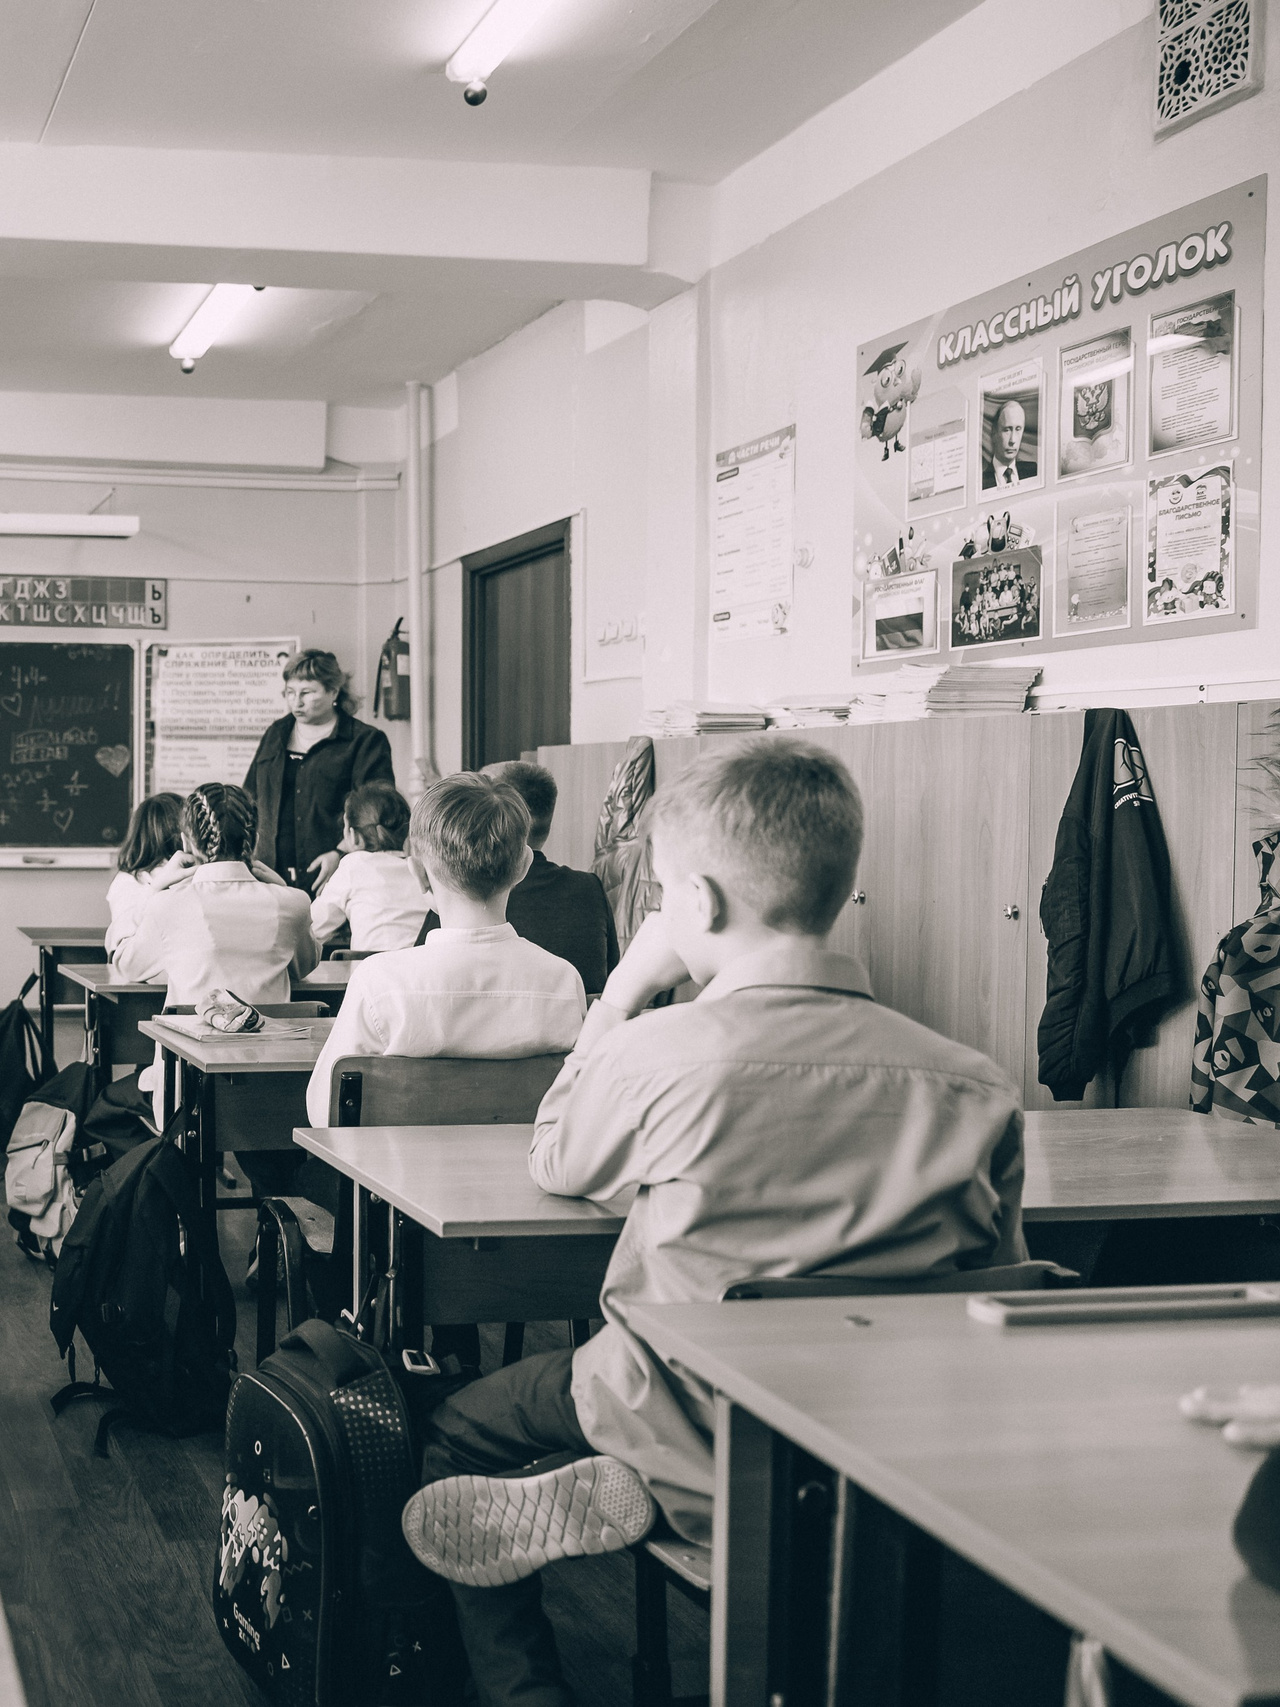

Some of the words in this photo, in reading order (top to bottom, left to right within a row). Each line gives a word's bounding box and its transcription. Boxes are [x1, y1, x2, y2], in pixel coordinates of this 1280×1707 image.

[938, 274, 1081, 366] КЛАССНЫЙ
[1092, 222, 1230, 306] УГОЛОК
[1175, 510, 1202, 521] ПИСЬМО
[201, 650, 270, 660] ОПРЕДЕЛИТЬ
[164, 660, 228, 668] СПРЯЖЕНИЕ
[234, 659, 282, 668] ГЛАГОЛА
[233, 1601, 261, 1651] Gaming
